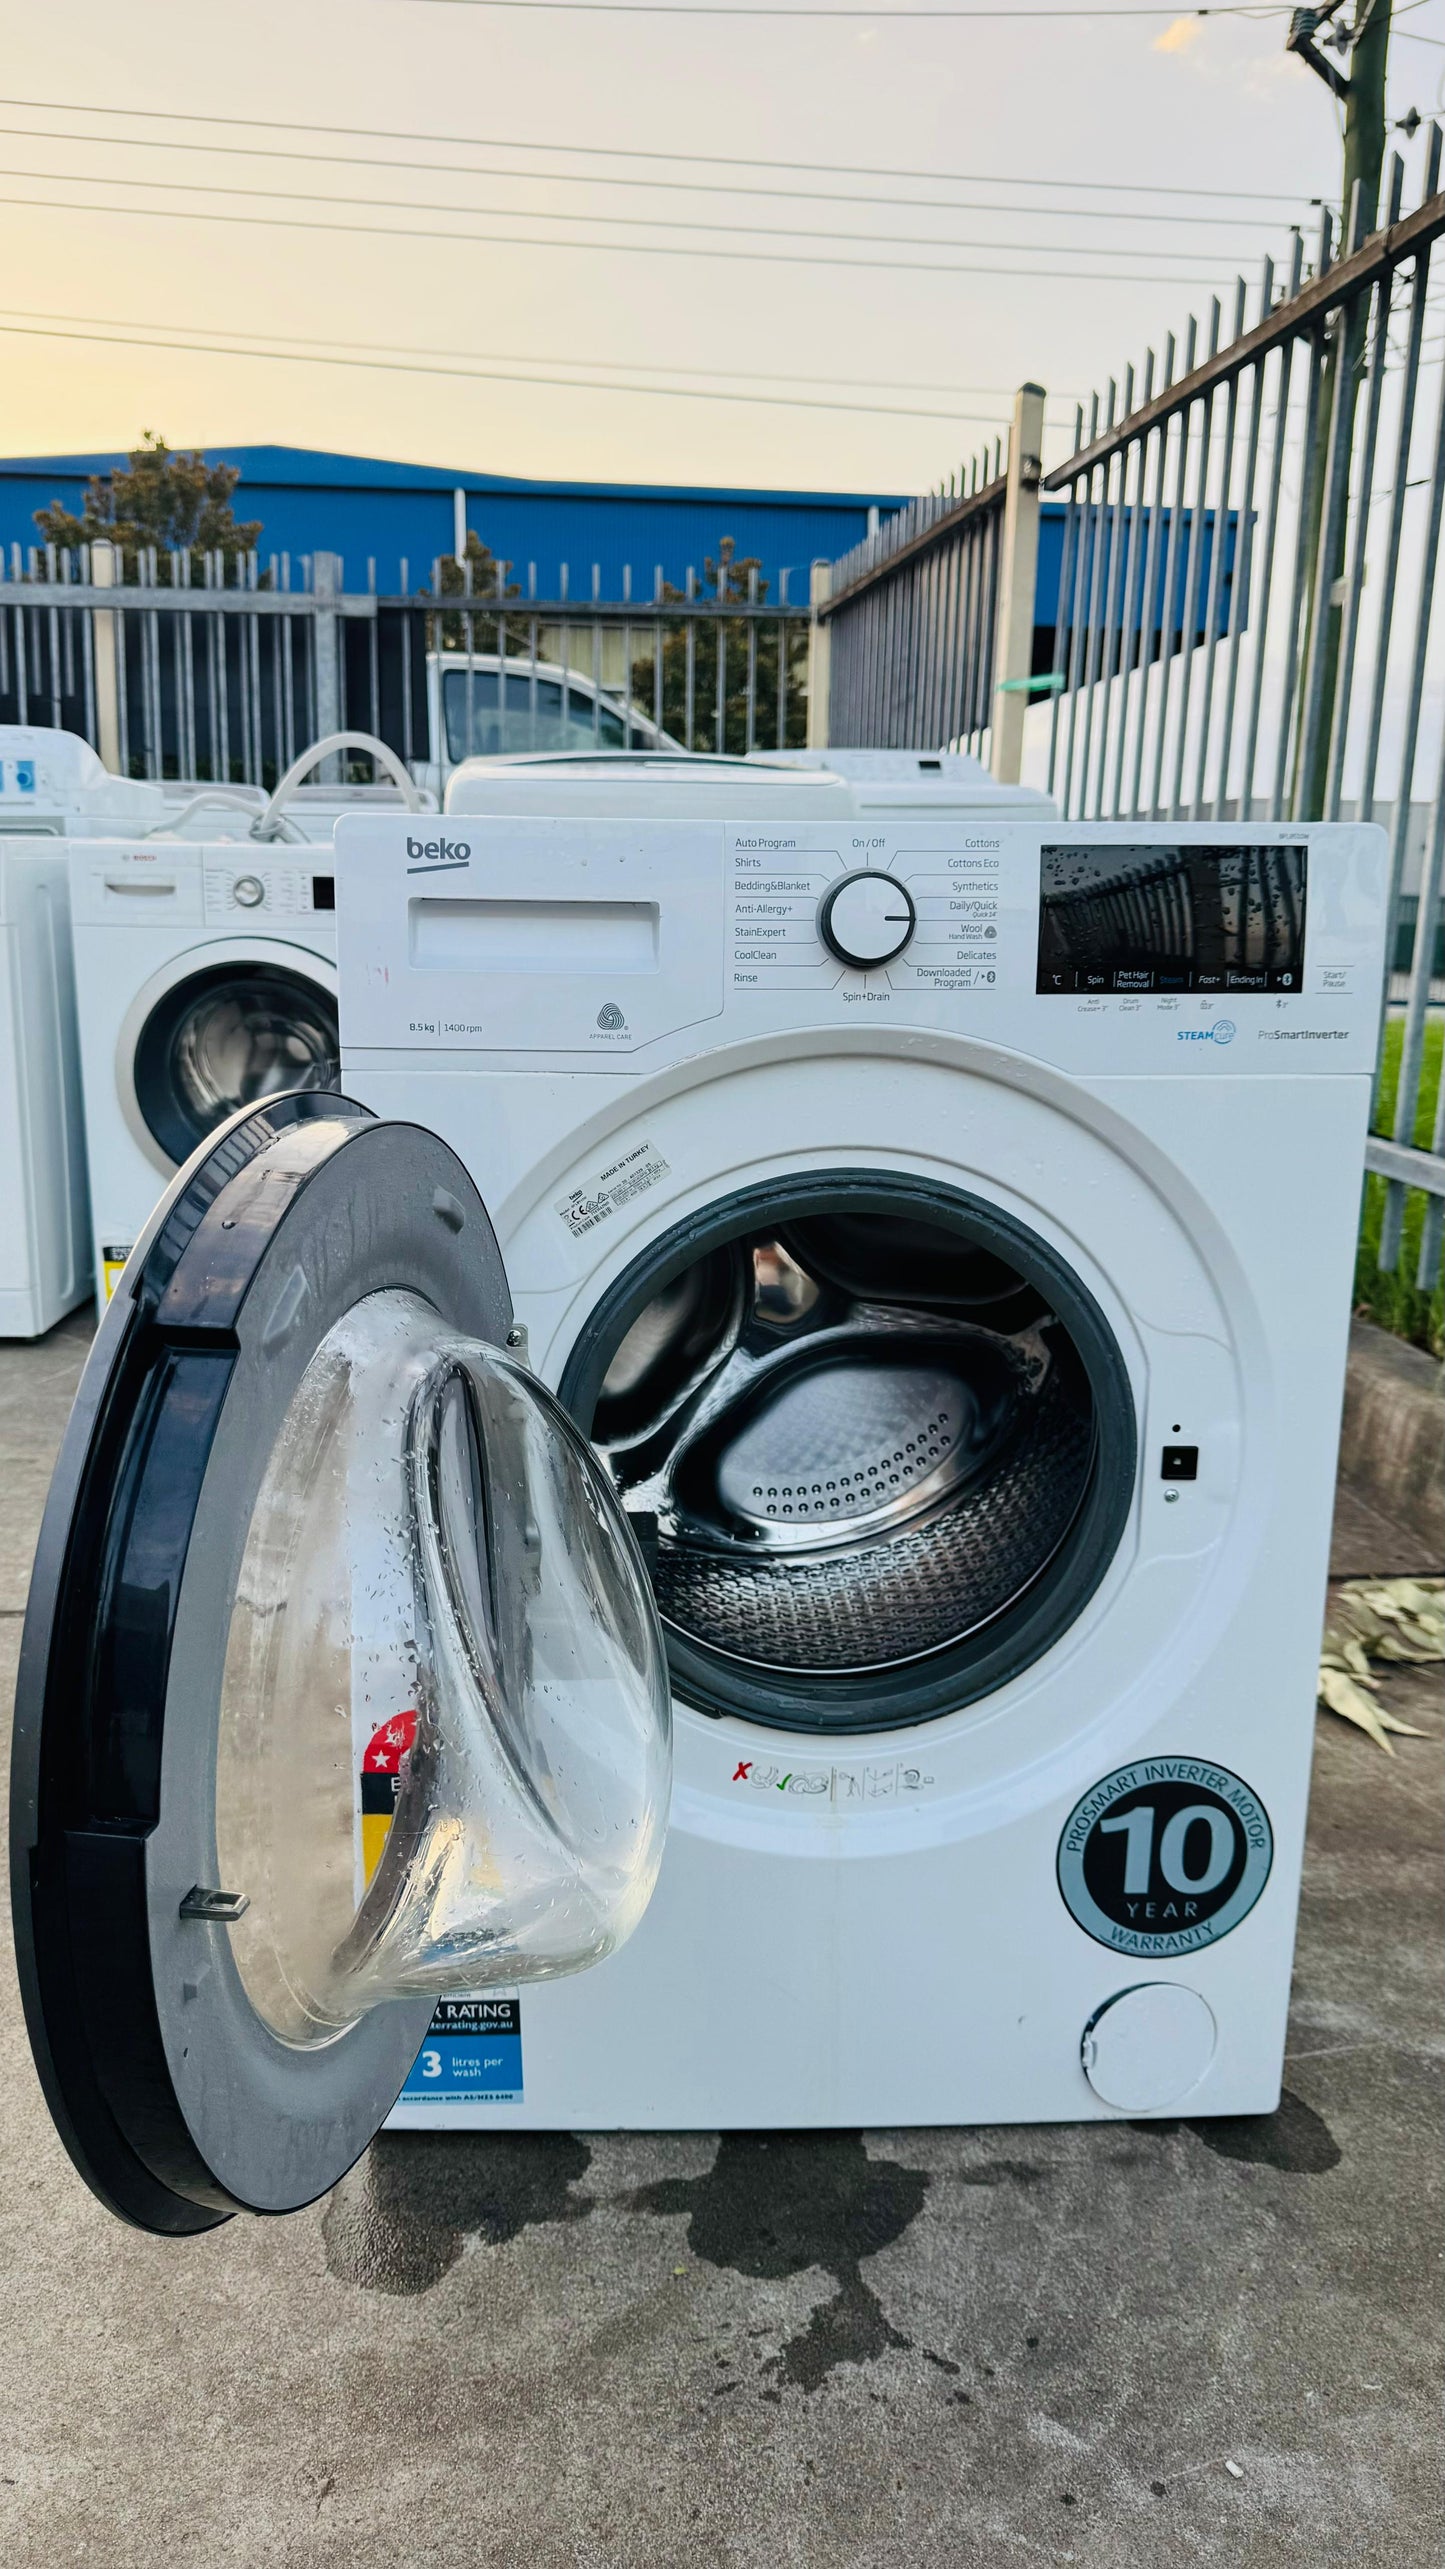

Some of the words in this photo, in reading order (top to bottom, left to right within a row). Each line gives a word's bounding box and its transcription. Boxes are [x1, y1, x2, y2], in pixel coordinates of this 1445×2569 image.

[736, 838, 757, 848] Auto
[759, 838, 796, 850] Program
[965, 838, 1000, 848] Cottons
[406, 837, 471, 860] beko
[736, 858, 761, 867] Shirts
[948, 858, 982, 868] Cottons
[983, 859, 1000, 868] Eco
[734, 882, 810, 892] Bedding&Blanket
[952, 882, 998, 892] Synthetics
[736, 904, 792, 915] Anti-Allergy+
[949, 901, 998, 912] Daily/Quick
[736, 928, 786, 938] StainExpert
[961, 924, 982, 932] Wool
[734, 951, 776, 960] CoolClean
[956, 950, 996, 960] Delicates
[734, 974, 758, 982] Rinse
[917, 968, 971, 978] Downloaded
[1118, 971, 1132, 979] Pet
[1133, 971, 1149, 979] Hair
[934, 978, 971, 988] Program
[1087, 976, 1104, 986] Spin
[1116, 980, 1150, 988] Removal
[1198, 975, 1220, 984] Fast+
[1230, 975, 1255, 986] Ending
[842, 992, 890, 1002] Spin+Drain
[409, 1022, 423, 1032] 8.5
[424, 1022, 435, 1034] kg
[444, 1023, 464, 1032] 1400
[466, 1025, 482, 1034] rpm
[1258, 1030, 1349, 1040] ProSmartInverter
[600, 1166, 618, 1181] MADE
[617, 1160, 626, 1169] IN
[626, 1144, 649, 1163] TURKEY
[1066, 1770, 1138, 1852] PROSMART
[1145, 1763, 1228, 1792] INVERTER
[1228, 1788, 1266, 1849] MOTOR
[1100, 1804, 1236, 1894] 10
[1126, 1902, 1198, 1918] YEAR
[1110, 1922, 1218, 1950] WARRANTY
[447, 2004, 511, 2018] RATING
[422, 2050, 442, 2078] 3
[453, 2057, 481, 2067] litres
[484, 2058, 503, 2068] per
[453, 2067, 482, 2077] wash
